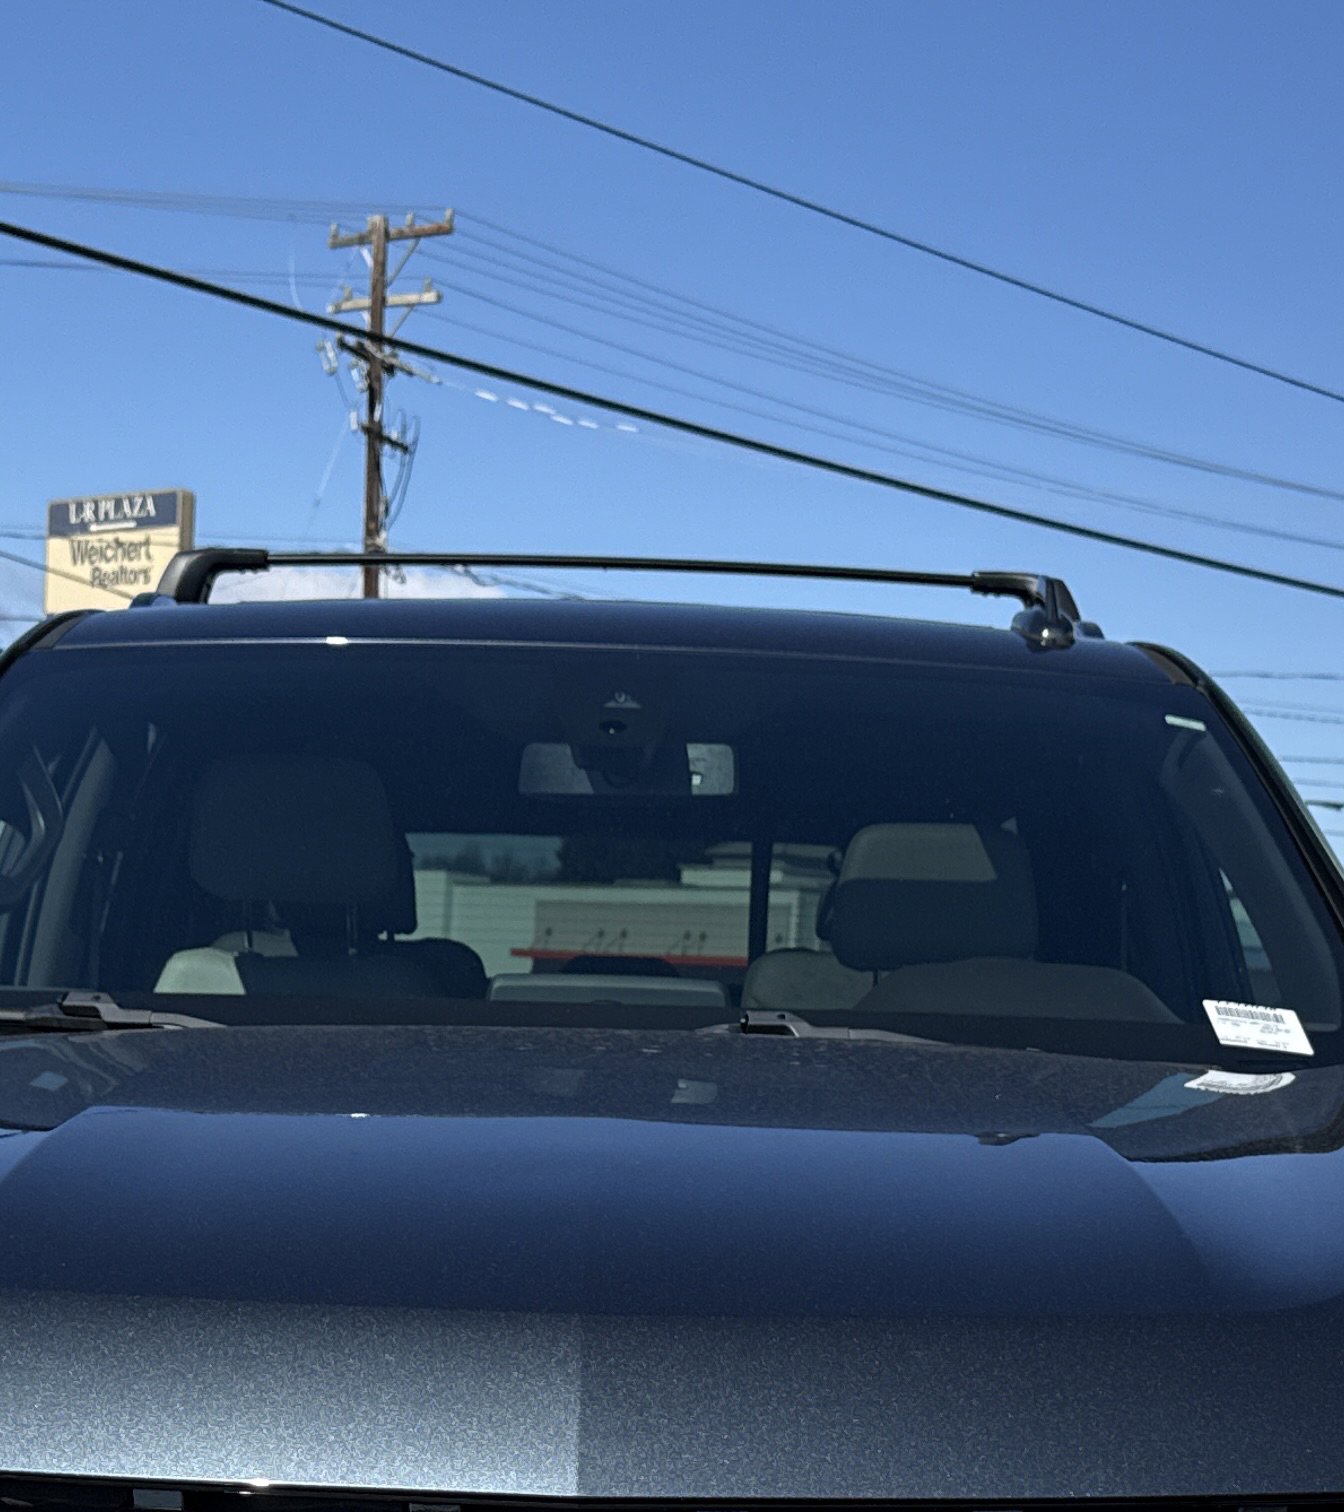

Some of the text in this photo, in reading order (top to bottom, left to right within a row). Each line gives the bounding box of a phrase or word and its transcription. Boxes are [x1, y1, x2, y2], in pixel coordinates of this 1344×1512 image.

[97, 494, 157, 520] PLAZA
[70, 535, 152, 566] Weichert
[91, 566, 152, 588] Realtors
